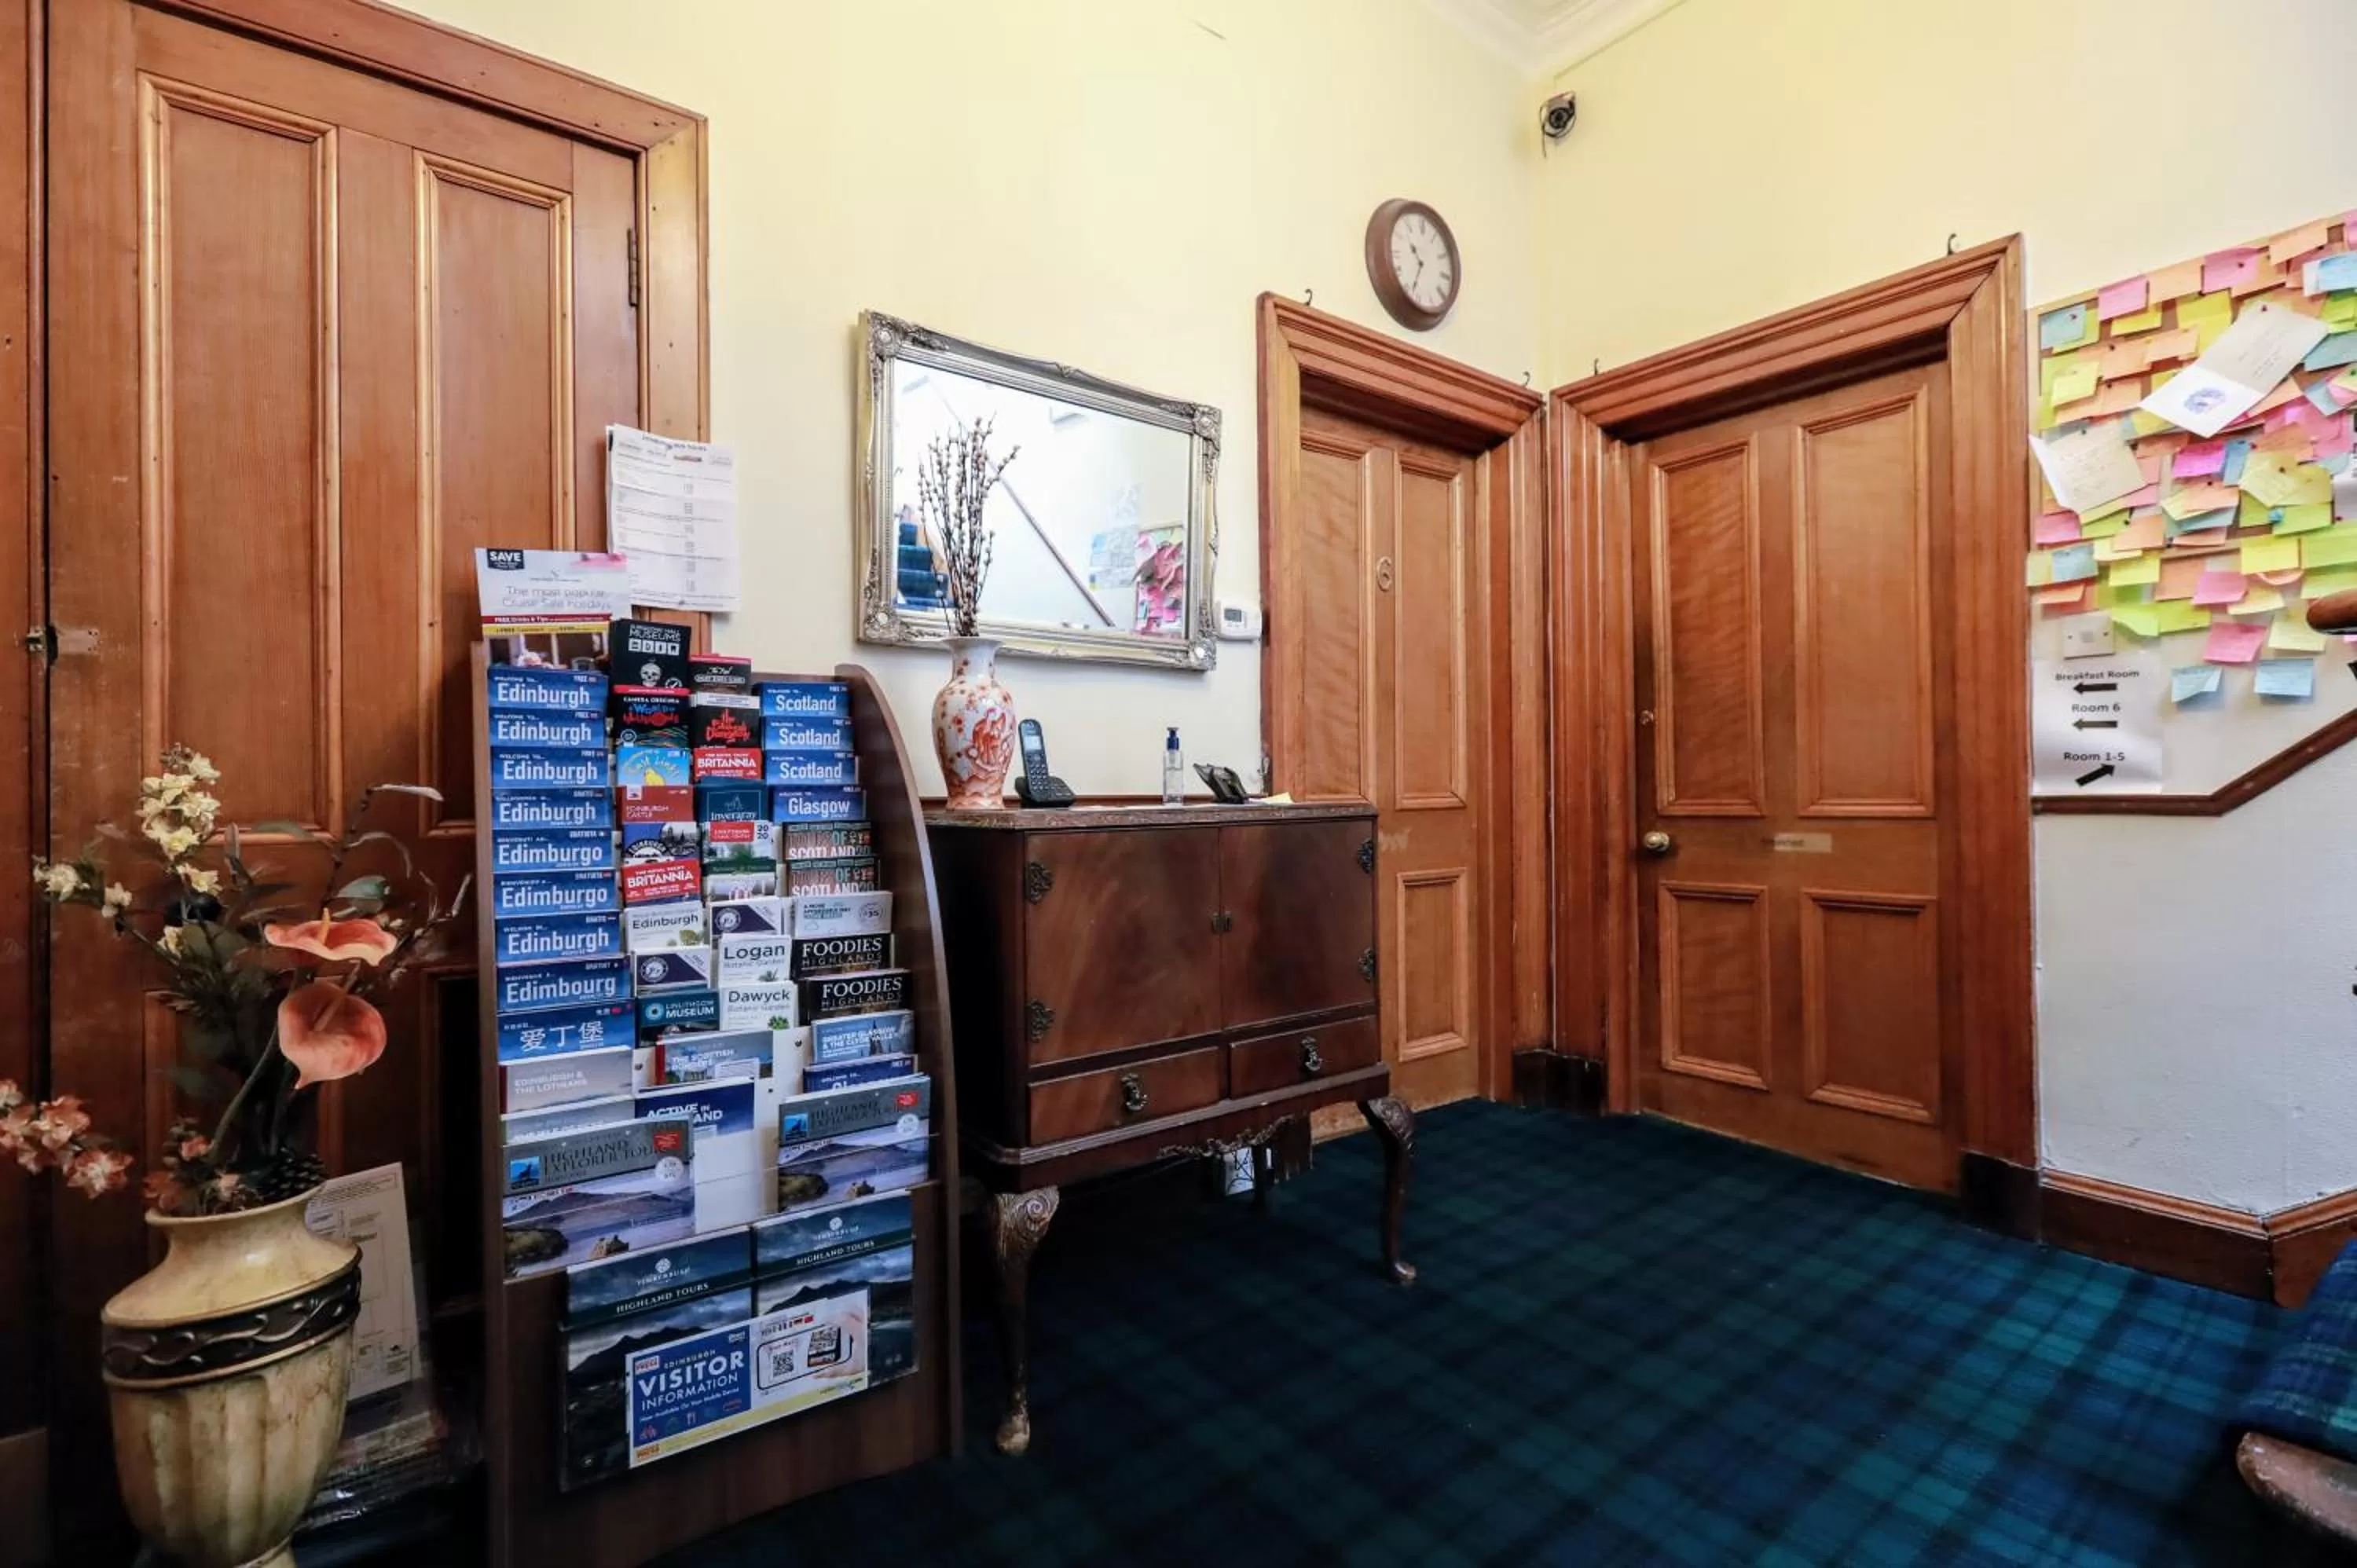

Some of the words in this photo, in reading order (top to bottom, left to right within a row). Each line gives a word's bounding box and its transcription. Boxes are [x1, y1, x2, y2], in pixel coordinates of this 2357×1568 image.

[489, 551, 522, 562] SAVE
[629, 629, 681, 642] MUSEUMS
[2055, 671, 2104, 681] Breakfast
[497, 683, 590, 709] Edinburgh
[775, 694, 837, 711] Scotland
[2072, 703, 2109, 713] Room
[2113, 702, 2121, 713] 6
[497, 721, 592, 745] Edinburgh
[779, 727, 840, 746] Scotland
[698, 758, 757, 768] BRITANNIA
[2064, 752, 2101, 761] Room
[2105, 752, 2125, 761] 1-5
[503, 760, 598, 784] Edinburgh
[779, 762, 842, 779] Scotland
[500, 802, 596, 825] Edinburgh
[788, 797, 850, 818] Glasgow
[711, 811, 757, 822] Inveraray
[832, 830, 847, 845] OF
[499, 844, 603, 866] Edimburgo
[789, 846, 855, 859] SCOTLAND
[627, 870, 694, 888] BRITANNIA
[836, 867, 851, 882] OF
[502, 885, 607, 907] Edimburgo
[792, 882, 859, 896] SCOTLAND
[632, 914, 698, 929] Edinburgh
[508, 928, 609, 954] Edinburgh
[802, 938, 883, 957] FOODIES
[724, 945, 786, 962] Logan
[507, 976, 616, 1003] Edimbourg
[728, 989, 790, 1003] Dawyck
[823, 977, 902, 998] FOODIES
[665, 1006, 714, 1019] MUSEUM
[647, 1102, 698, 1119] ACTIVE
[796, 1248, 844, 1266] HIGHLAND
[846, 1240, 875, 1252] TOURS
[617, 1292, 673, 1313] HIGHLAND
[676, 1283, 709, 1298] TOURS
[664, 1349, 716, 1368] EDINBURGH
[638, 1350, 744, 1397] VISITOR
[642, 1372, 738, 1412] INFORMATION
